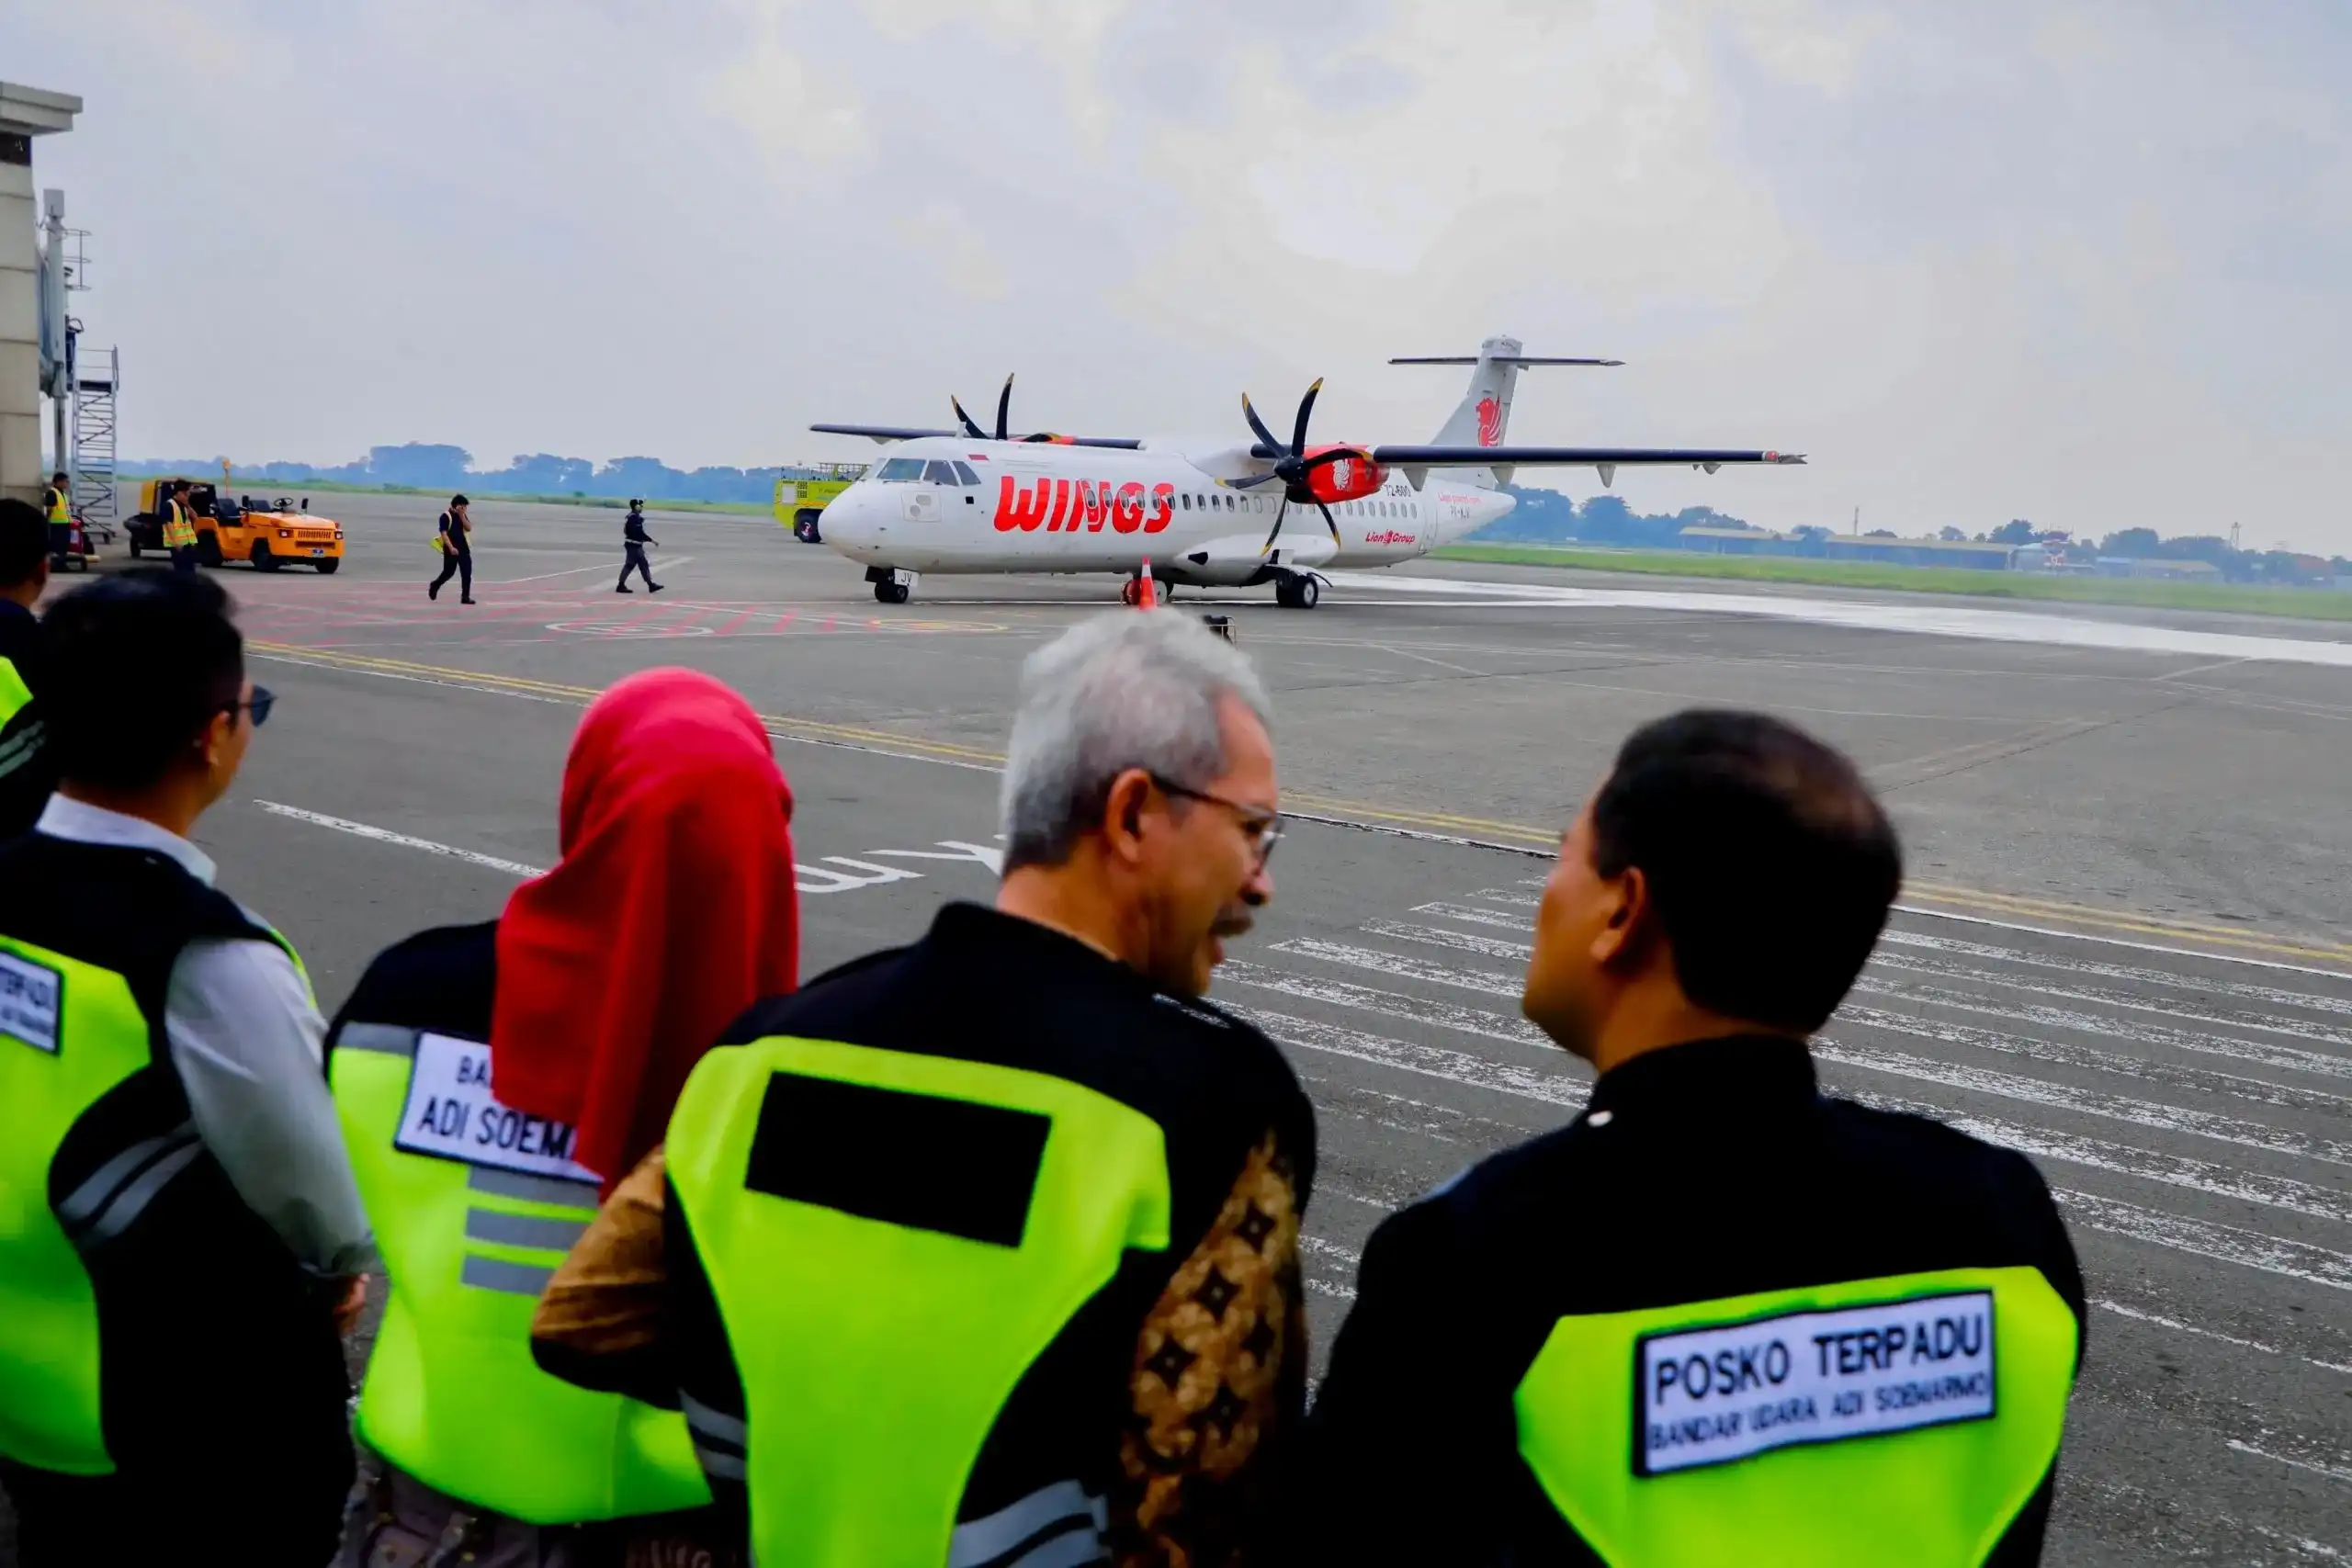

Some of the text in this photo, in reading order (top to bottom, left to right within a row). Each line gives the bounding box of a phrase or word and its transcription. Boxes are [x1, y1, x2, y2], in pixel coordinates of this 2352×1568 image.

[993, 475, 1174, 533] WINGS
[1365, 531, 1416, 545] Lion Group
[900, 572, 912, 583] JV
[417, 1095, 470, 1140] ADI
[1657, 1314, 1984, 1406] POSKO TERPADU
[1650, 1411, 1741, 1451] BANDAR
[1832, 1389, 1864, 1418] ADI
